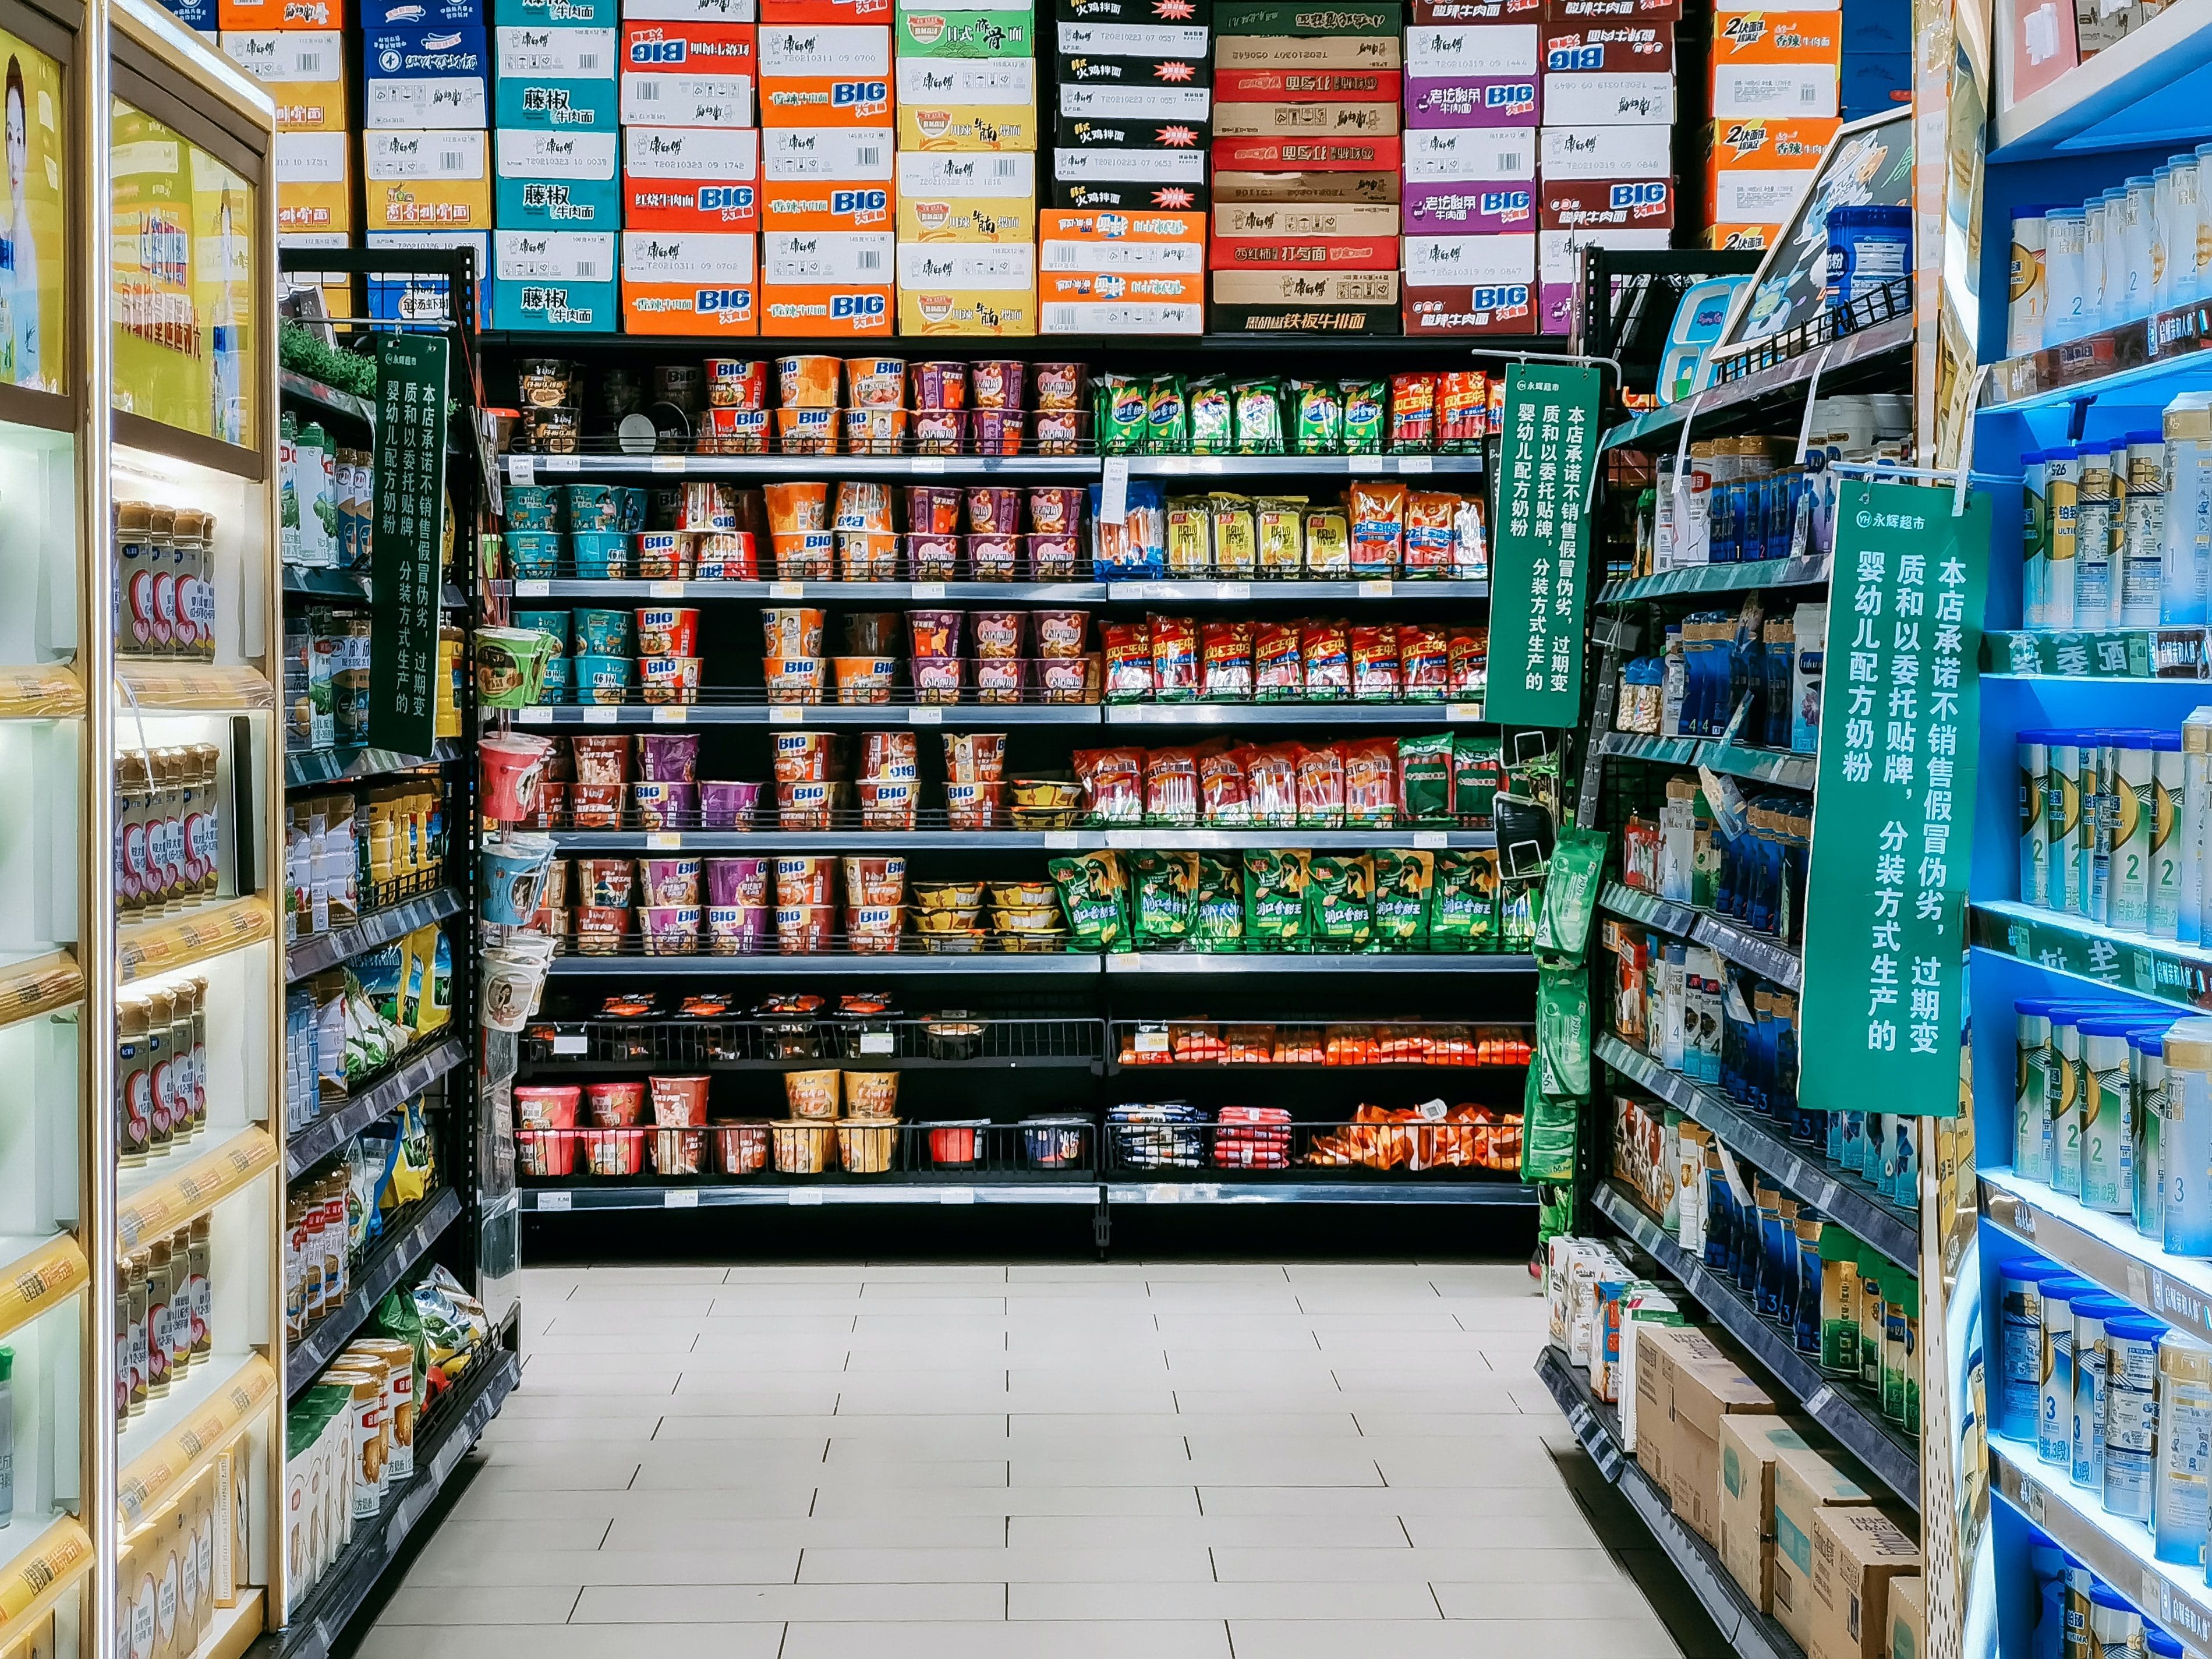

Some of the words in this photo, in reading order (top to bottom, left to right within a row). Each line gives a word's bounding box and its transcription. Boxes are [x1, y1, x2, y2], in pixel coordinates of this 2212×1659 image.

[556, 6, 593, 19] 牛肉面
[1076, 2, 1121, 16] 火鸡拌面
[632, 41, 684, 63] BIG
[1549, 47, 1603, 69] BIG
[1077, 66, 1121, 79] 火鸡拌面
[523, 87, 569, 111] 藤椒
[833, 83, 886, 102] BIG
[1431, 88, 1480, 103] 老坛酸菜
[1488, 86, 1534, 104] BIG
[556, 111, 594, 123] 牛肉面
[1080, 129, 1124, 143] 火鸡拌面
[523, 183, 569, 206] 藤椒
[635, 194, 694, 207] 红烧牛肉面
[700, 188, 753, 210] BIG
[833, 191, 886, 211] BIG
[1075, 192, 1121, 206] 火鸡拌面
[1612, 183, 1665, 207] BIG
[1426, 196, 1476, 211] 老坛酸菜
[1484, 192, 1530, 213] BIG
[556, 206, 594, 220] 牛肉面
[1435, 210, 1467, 221] 牛肉面
[1282, 246, 1326, 261] 打卤面
[2130, 271, 2137, 291] 2
[521, 286, 567, 310] 藤椒
[699, 290, 750, 310] BIG
[1475, 287, 1527, 310] BIG
[833, 296, 884, 316] BIG
[2072, 296, 2082, 316] 2
[555, 309, 592, 323] 牛肉面
[717, 363, 747, 376] BIG
[875, 362, 903, 374] BIG
[1527, 381, 1560, 391] 永辉超市
[736, 412, 765, 425] BIG
[798, 412, 829, 424] BIG
[383, 380, 399, 534] 婴幼儿配方奶粉
[1510, 403, 1535, 537] 婴幼儿配方奶粉
[1873, 512, 1926, 531] 永辉超市
[644, 536, 674, 549] BIG
[805, 536, 831, 547] BIG
[1526, 404, 1560, 691] 质和以委托贴牌，分装方式生产的
[1550, 406, 1585, 693] 本店承诺不销售假冒伪劣，过期变
[645, 613, 673, 625] BIG
[647, 661, 676, 674] BIG
[784, 661, 814, 673] BIG
[1842, 551, 1886, 784] 婴幼儿配方奶粉
[778, 737, 806, 749] BIG
[635, 786, 660, 798] BIG
[794, 787, 824, 799] BIG
[878, 787, 908, 799] BIG
[948, 787, 974, 798] BIG
[1868, 553, 1925, 1053] 质和以委托贴牌，分装方式生产的
[1909, 556, 1967, 1055] 本店承诺不销售假冒伪劣，过期变
[779, 861, 805, 873] BIG
[2126, 854, 2139, 880] 2
[2161, 859, 2174, 886] 2
[710, 910, 736, 922] BIG
[777, 910, 801, 924] BIG
[860, 910, 889, 924] BIG
[2067, 1123, 2079, 1148] 2
[2092, 1137, 2103, 1163] 2
[2174, 1177, 2185, 1203] 3
[2046, 1395, 2057, 1420] 3
